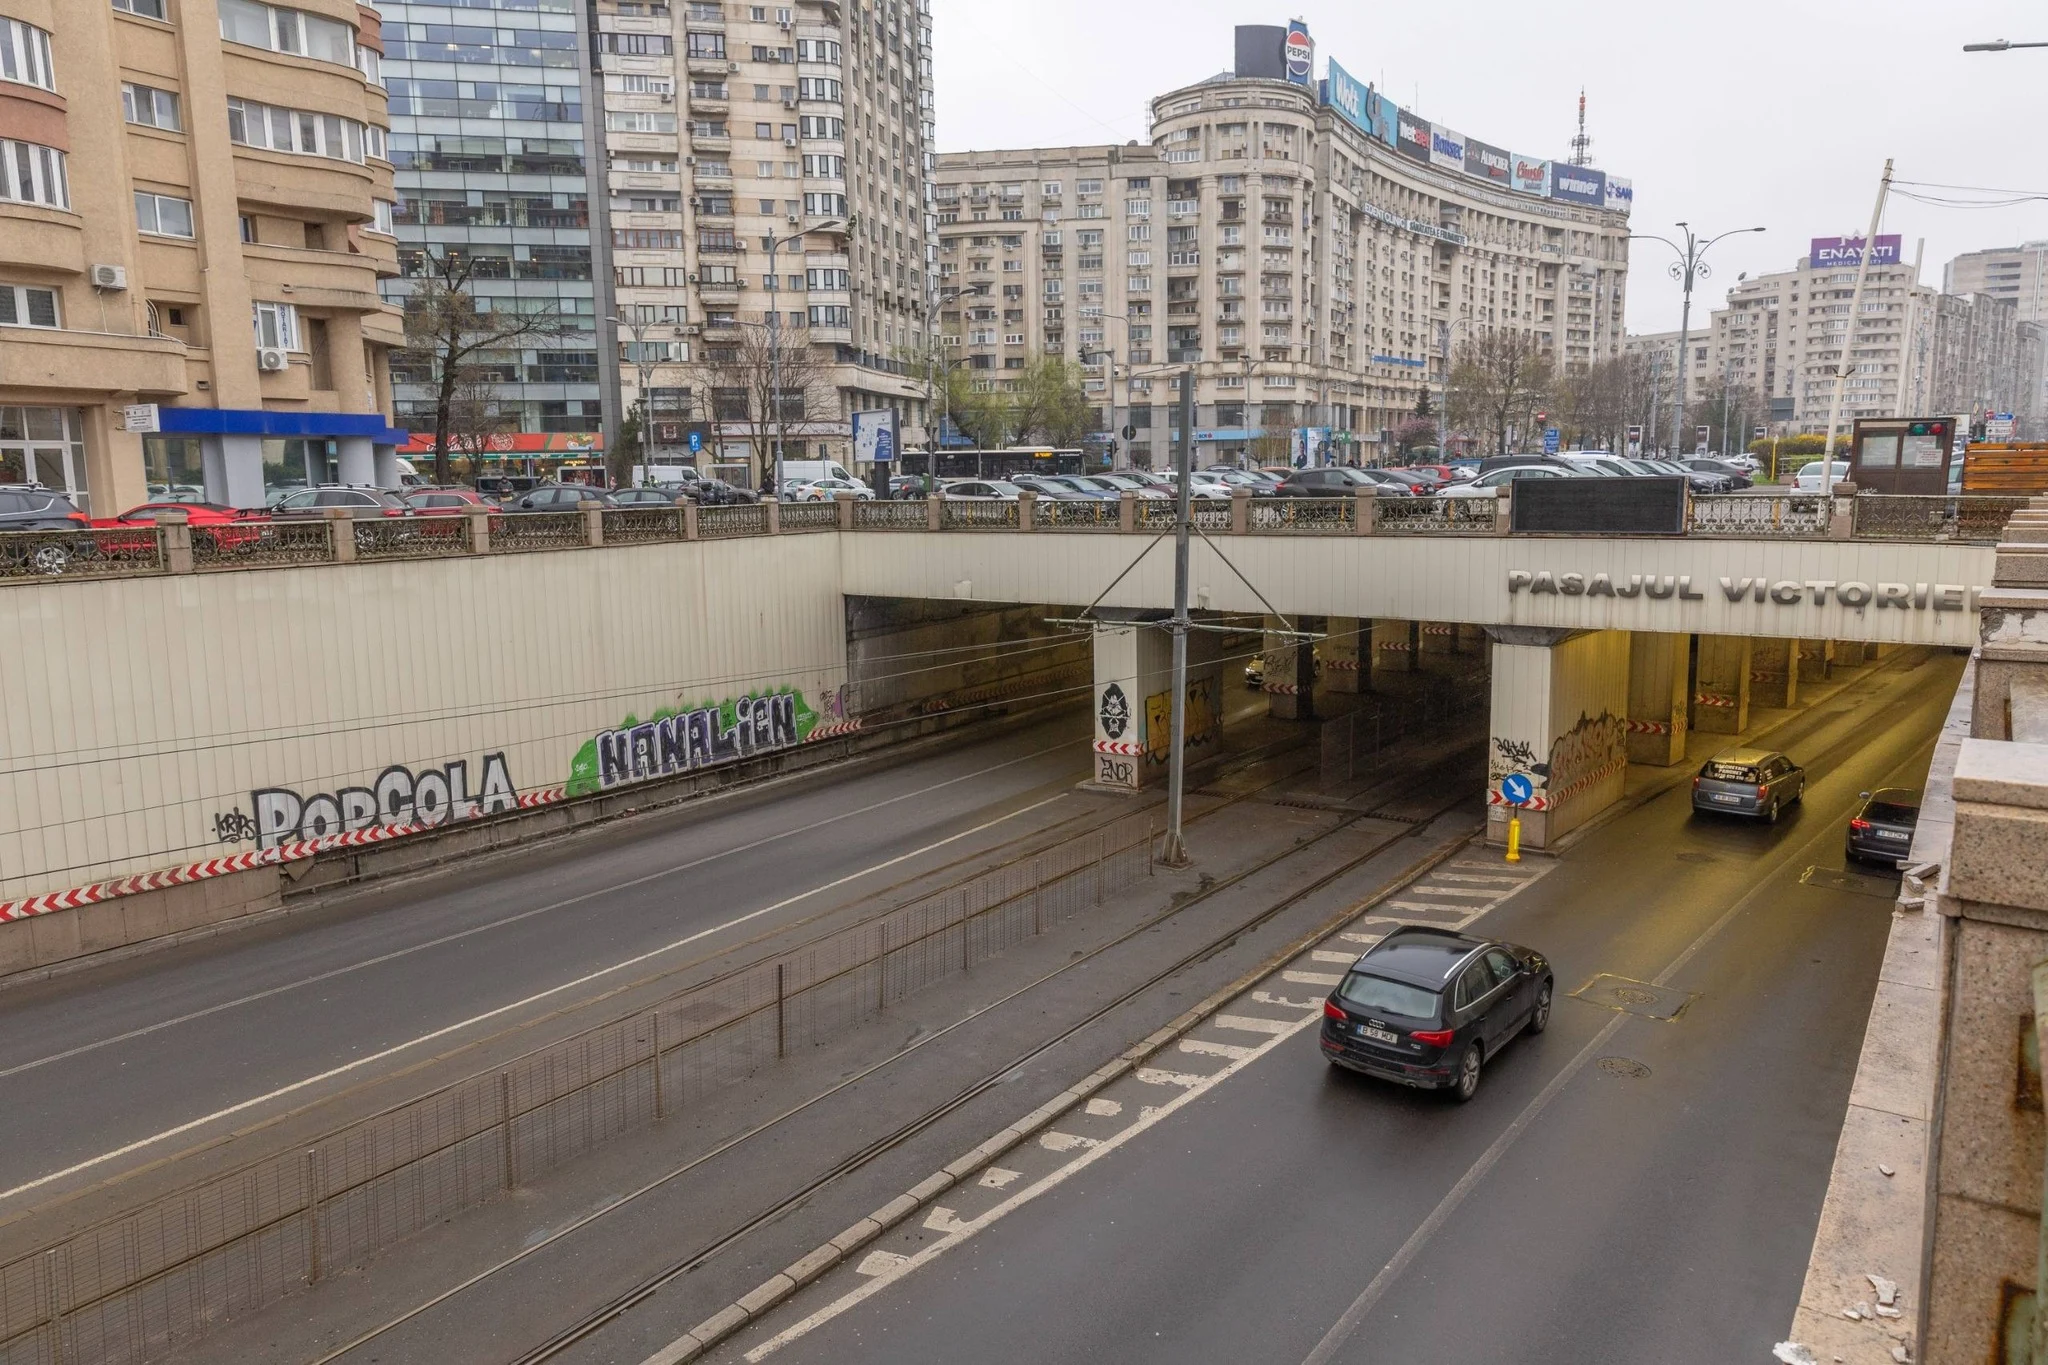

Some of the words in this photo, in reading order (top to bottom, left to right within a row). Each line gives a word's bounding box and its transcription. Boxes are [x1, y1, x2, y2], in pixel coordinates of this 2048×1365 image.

[1287, 45, 1310, 60] PEPSI
[1336, 72, 1359, 118] Wolt
[1517, 161, 1544, 182] Giusto
[1559, 174, 1598, 195] winner
[1819, 246, 1893, 259] ENAYATI
[692, 435, 697, 446] P
[1508, 570, 1704, 600] PASAJUL
[1719, 576, 1984, 612] VICTORIEI
[1363, 1026, 1368, 1034] B
